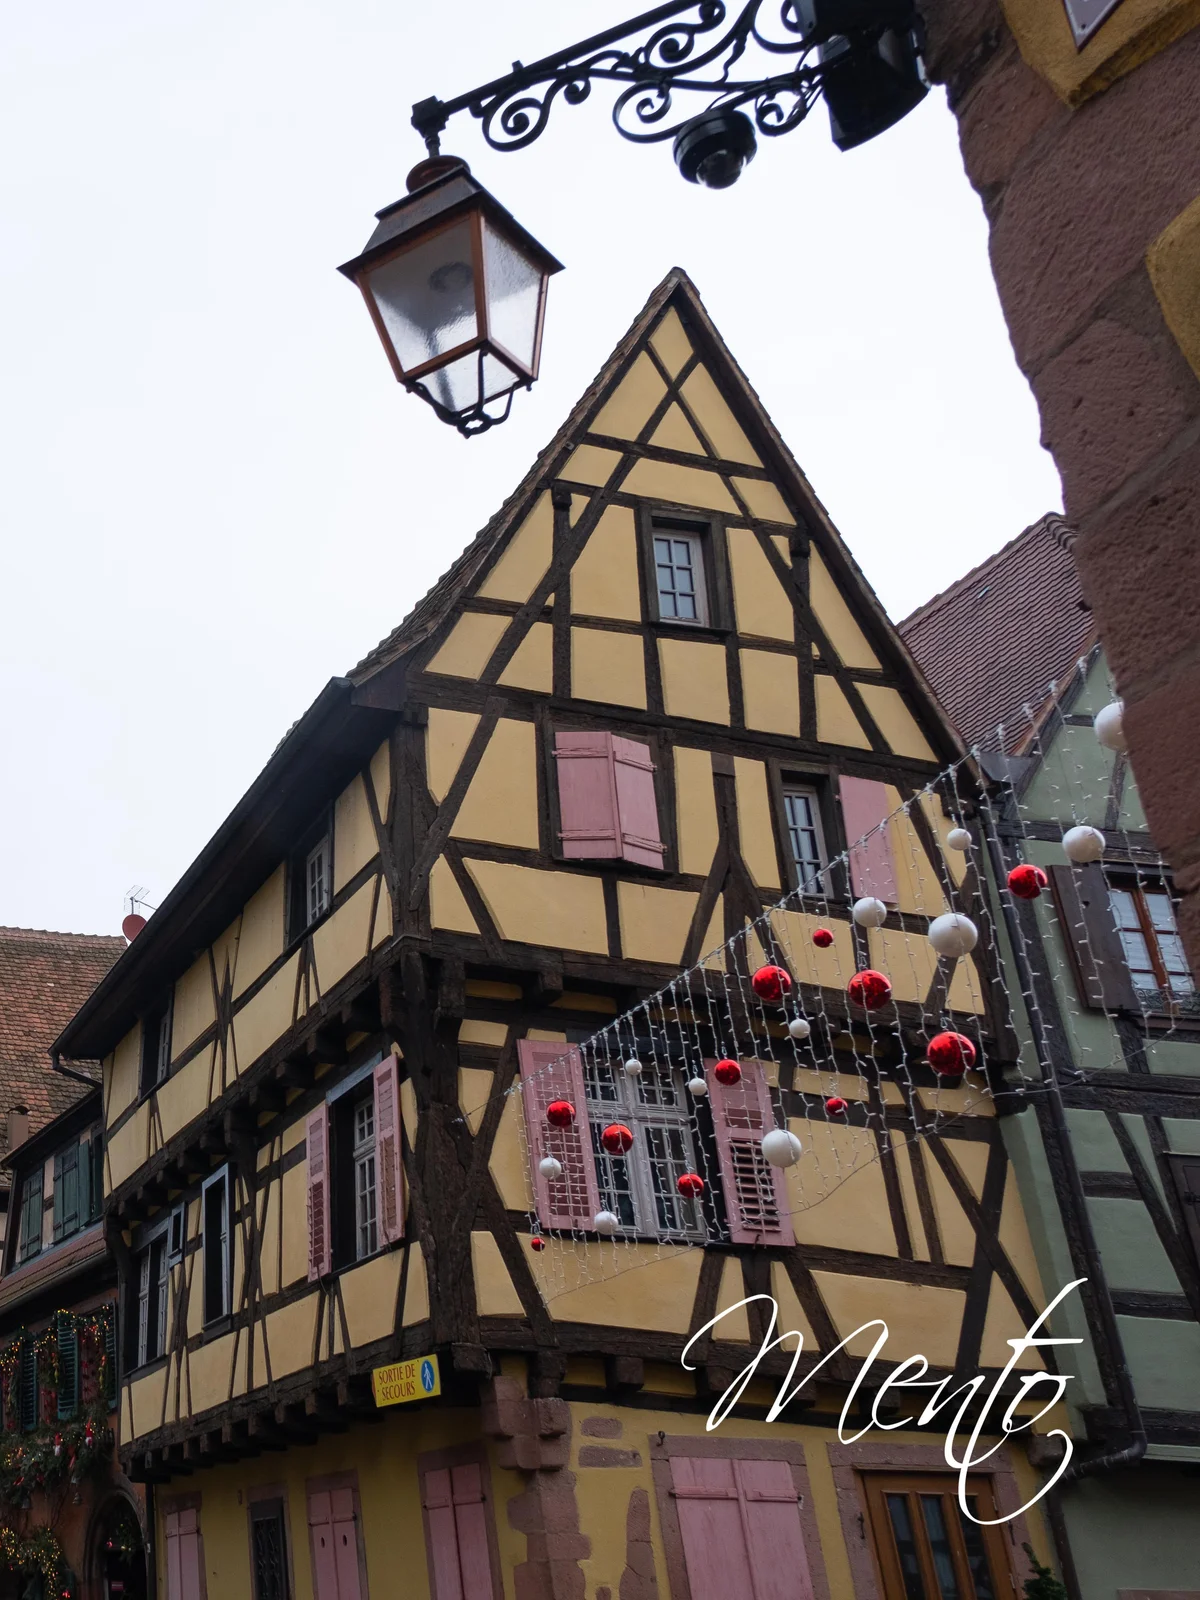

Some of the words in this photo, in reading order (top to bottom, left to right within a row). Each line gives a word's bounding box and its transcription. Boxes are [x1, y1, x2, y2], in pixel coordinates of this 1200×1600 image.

[379, 1366, 404, 1385] SORTIE
[405, 1363, 416, 1379] DE
[381, 1380, 416, 1401] SECOURS
